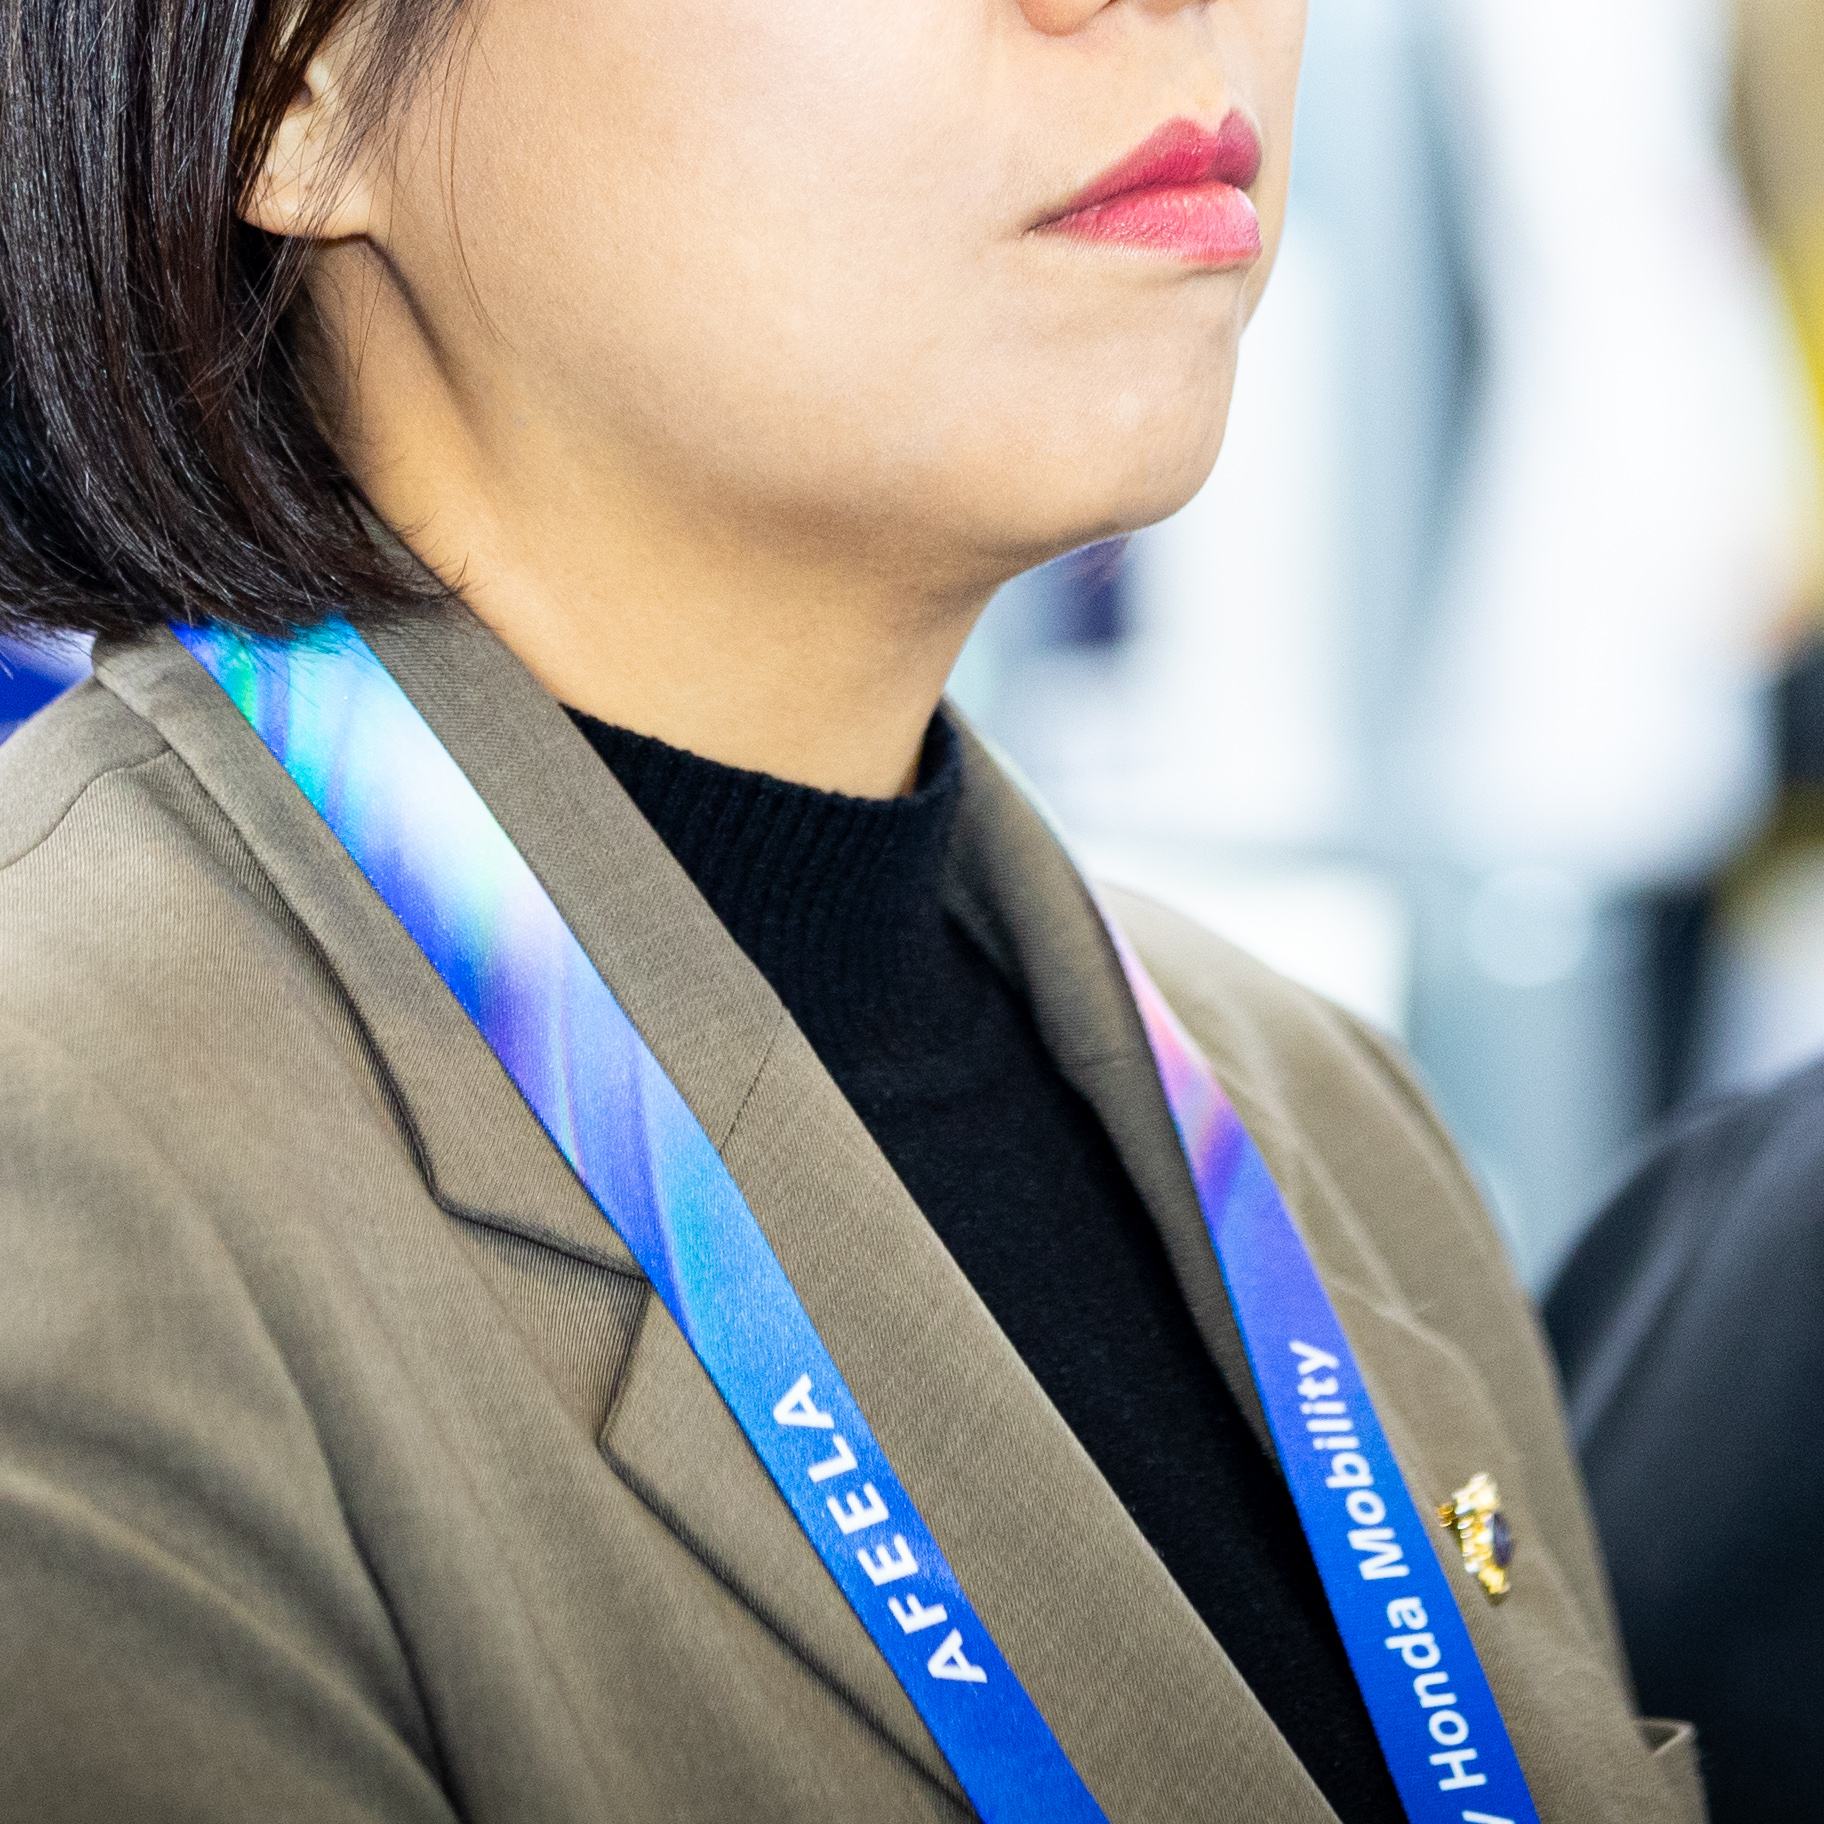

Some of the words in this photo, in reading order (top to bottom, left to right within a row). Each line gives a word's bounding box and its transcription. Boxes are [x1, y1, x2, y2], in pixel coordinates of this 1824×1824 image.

[773, 1374, 988, 1683] AFEELA
[1289, 1341, 1409, 1580] Mobility
[1385, 1597, 1487, 1791] Honda
